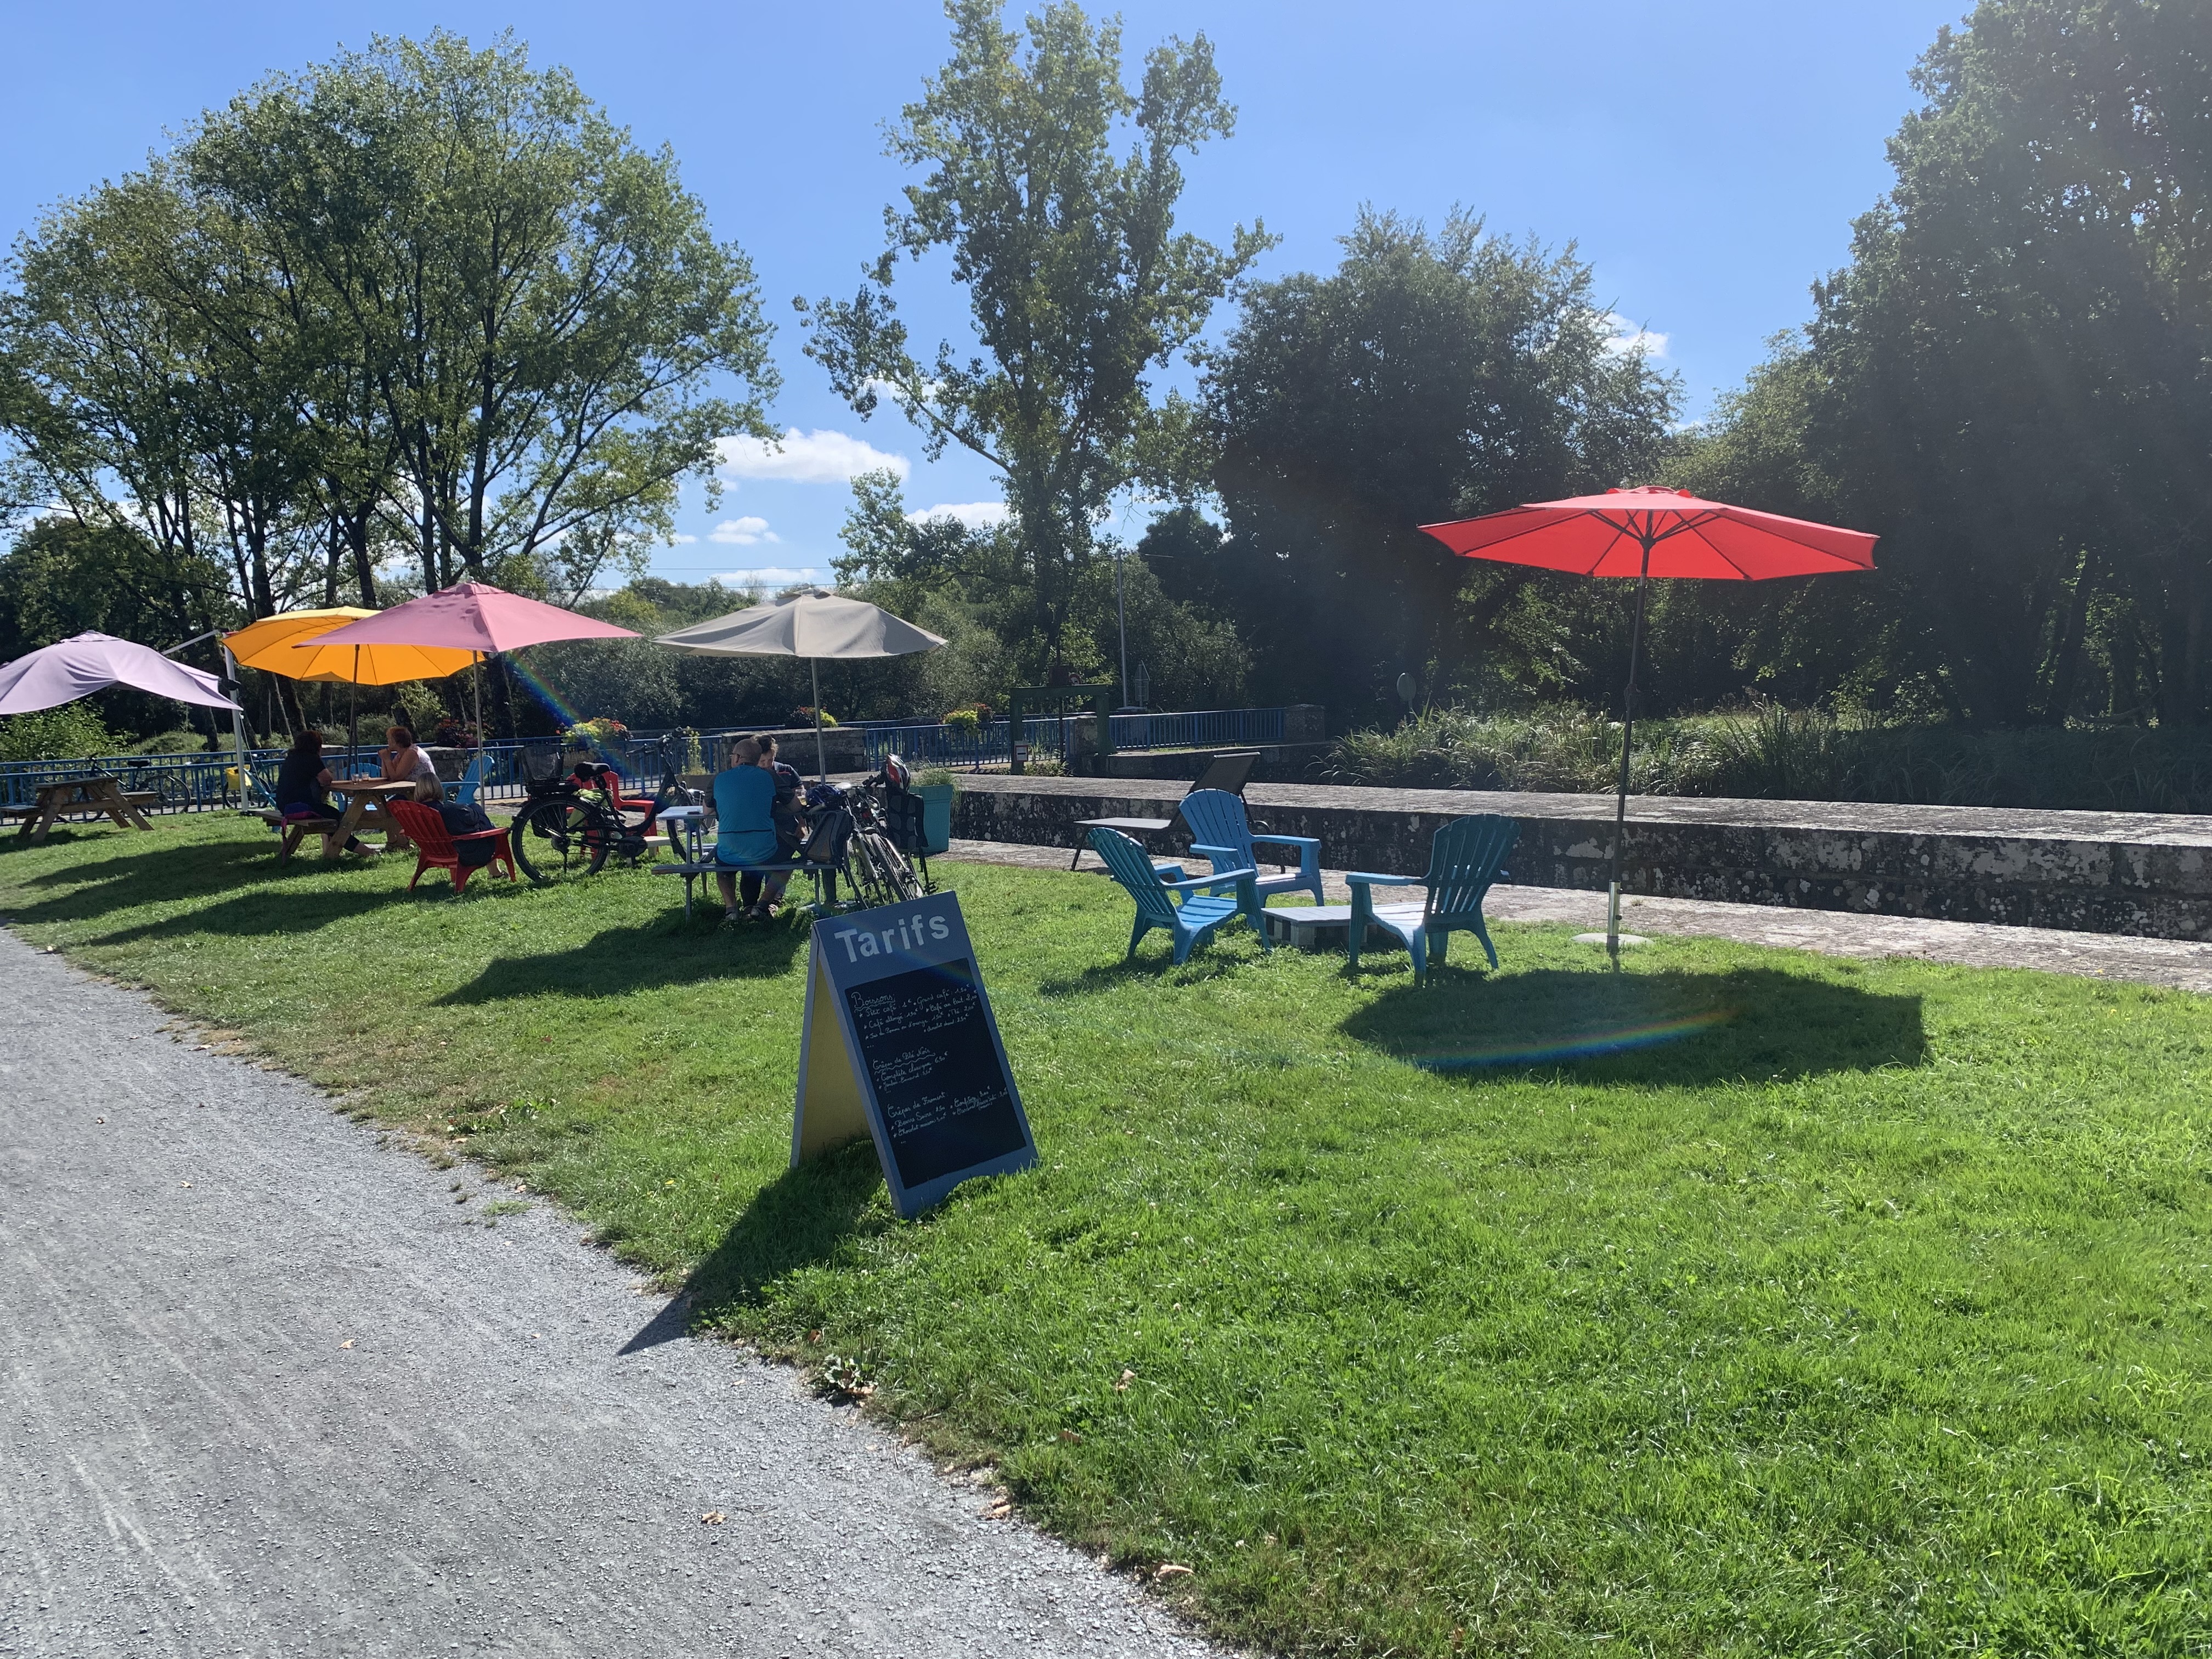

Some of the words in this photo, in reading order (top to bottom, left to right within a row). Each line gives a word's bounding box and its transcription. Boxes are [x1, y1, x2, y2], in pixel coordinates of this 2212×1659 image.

[834, 914, 949, 963] Tarifs
[917, 994, 934, 1009] Grand
[936, 989, 950, 1000] café
[883, 1003, 896, 1015] café
[929, 1002, 942, 1014] Café
[869, 1018, 884, 1029] Café
[917, 1047, 930, 1057] Noir
[887, 1104, 911, 1118] Crêpes
[913, 1101, 921, 1109] de
